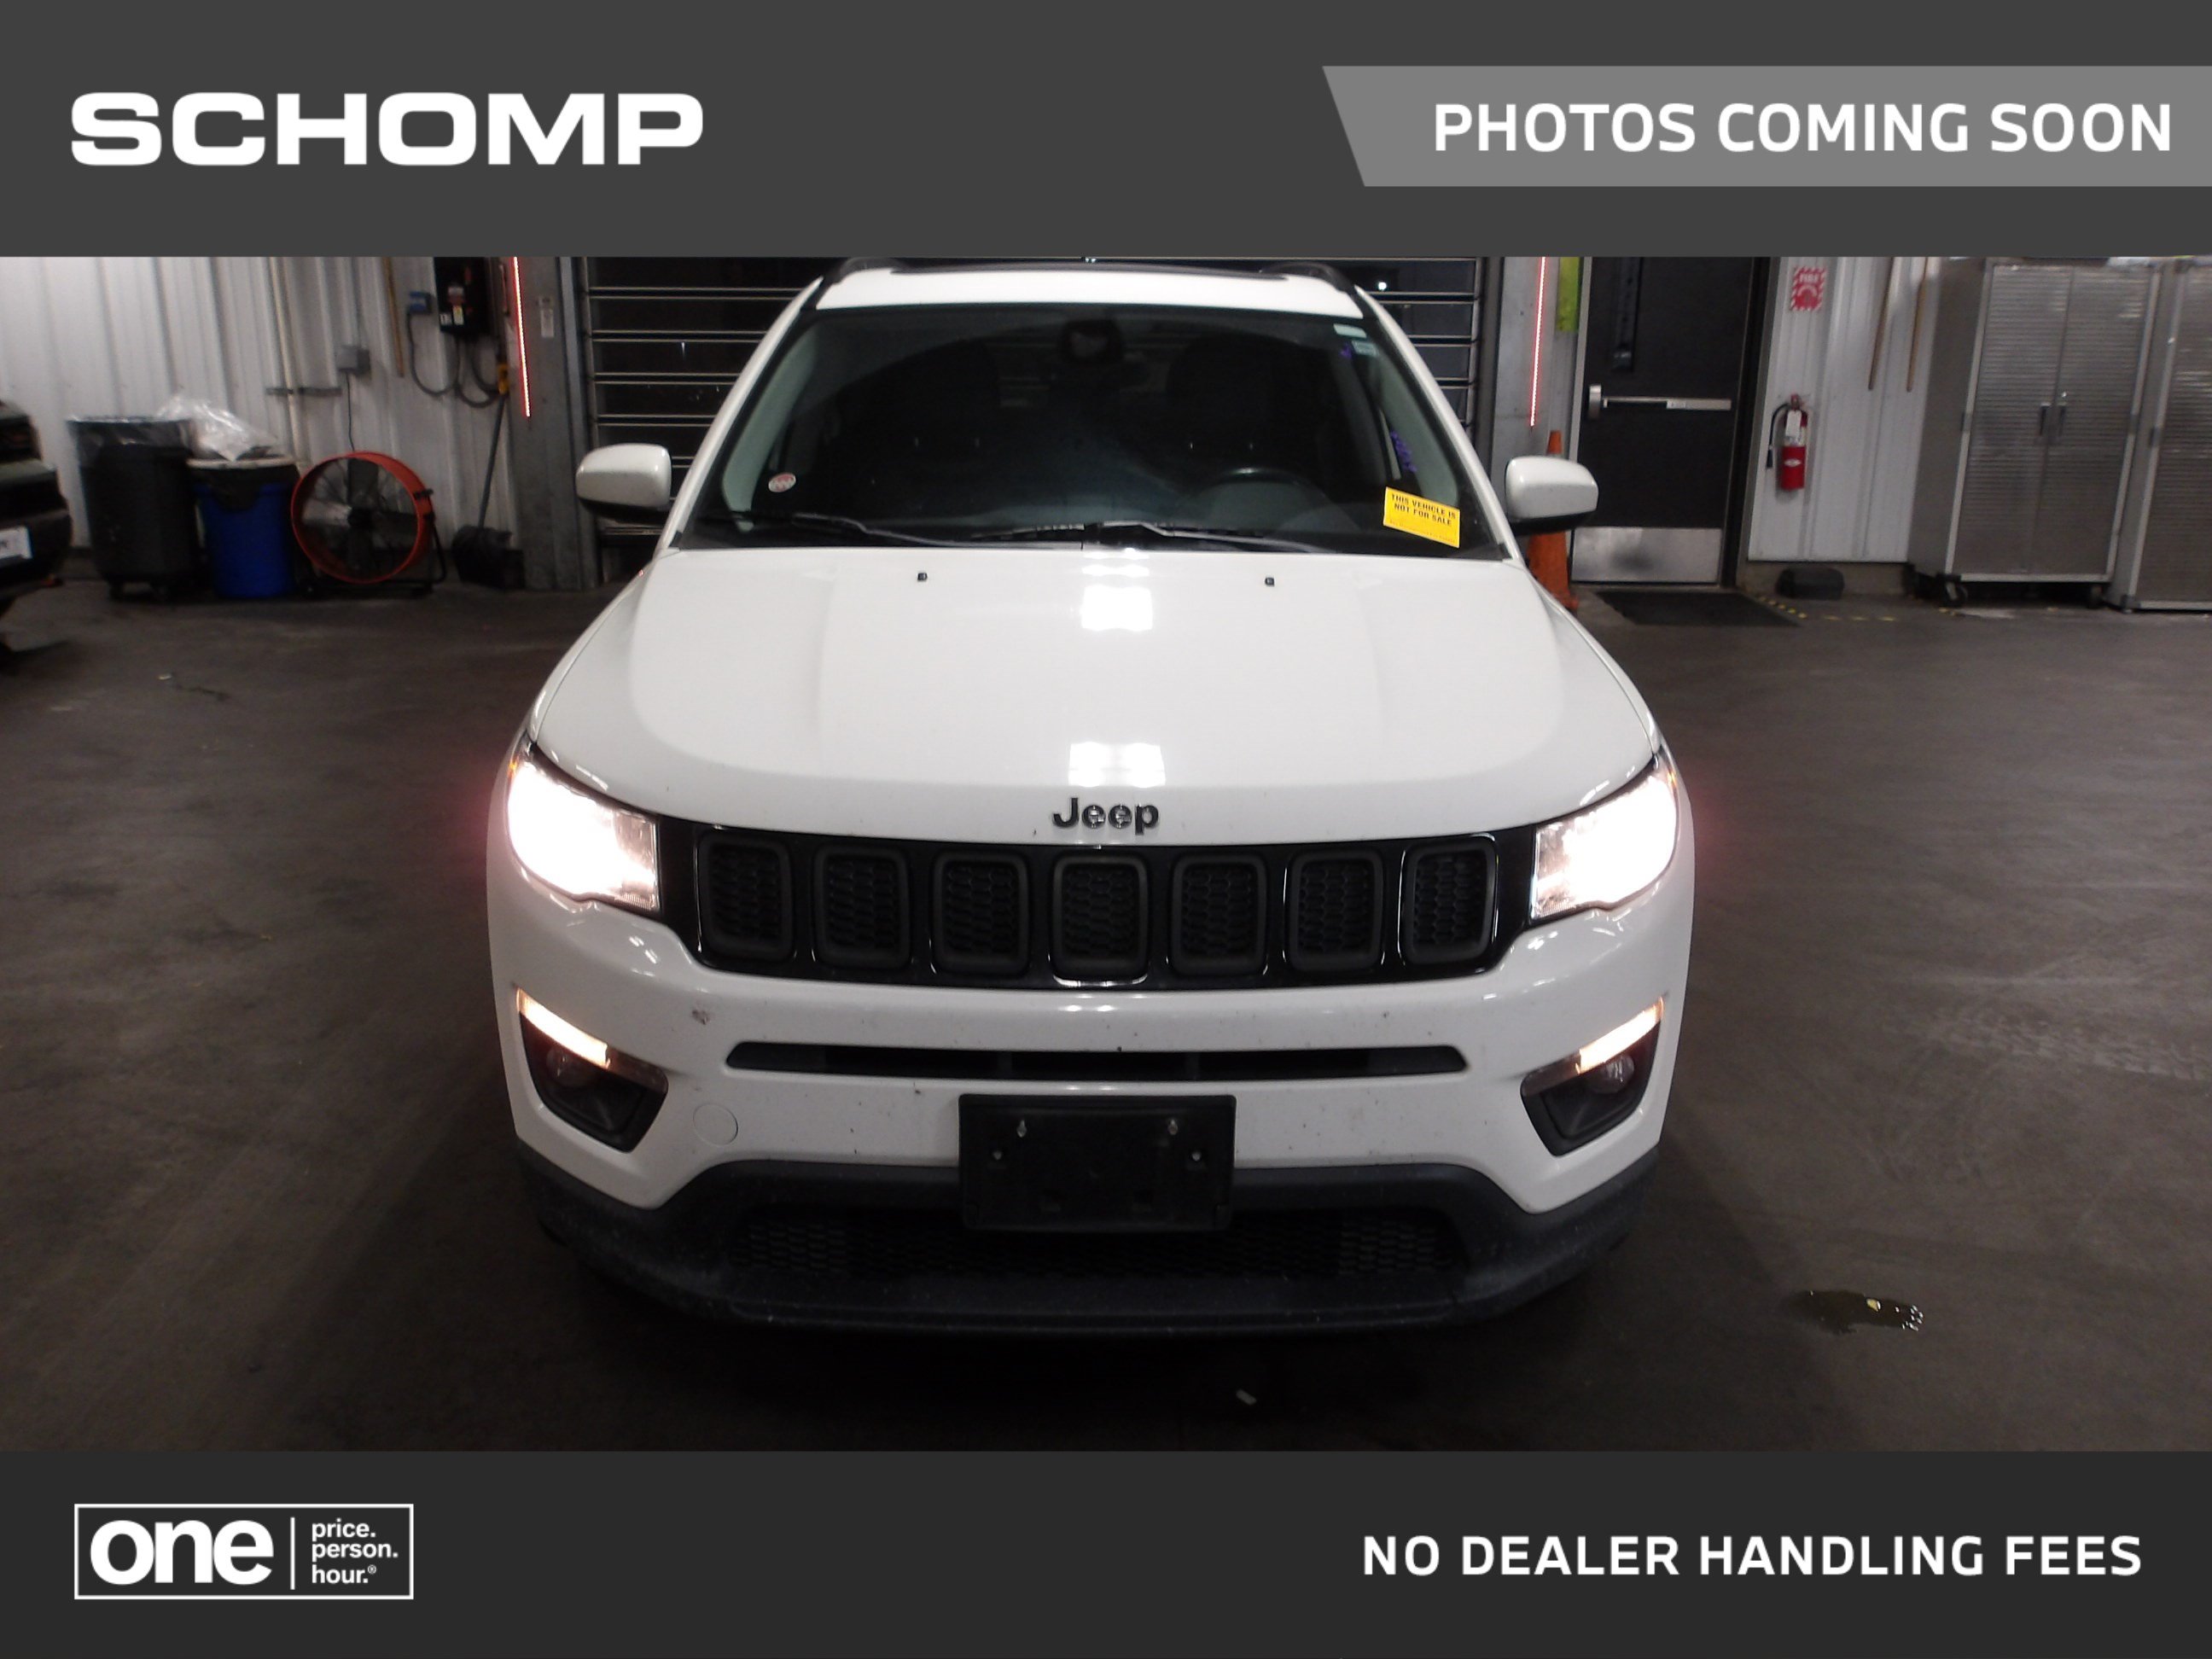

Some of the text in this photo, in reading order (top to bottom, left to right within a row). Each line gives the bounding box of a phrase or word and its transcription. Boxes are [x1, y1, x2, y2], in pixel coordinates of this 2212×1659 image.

[1392, 493, 1456, 520] THIS VEHICLE IS
[1394, 503, 1452, 526] NOT FOR SALE
[1053, 797, 1159, 835] Jeep
